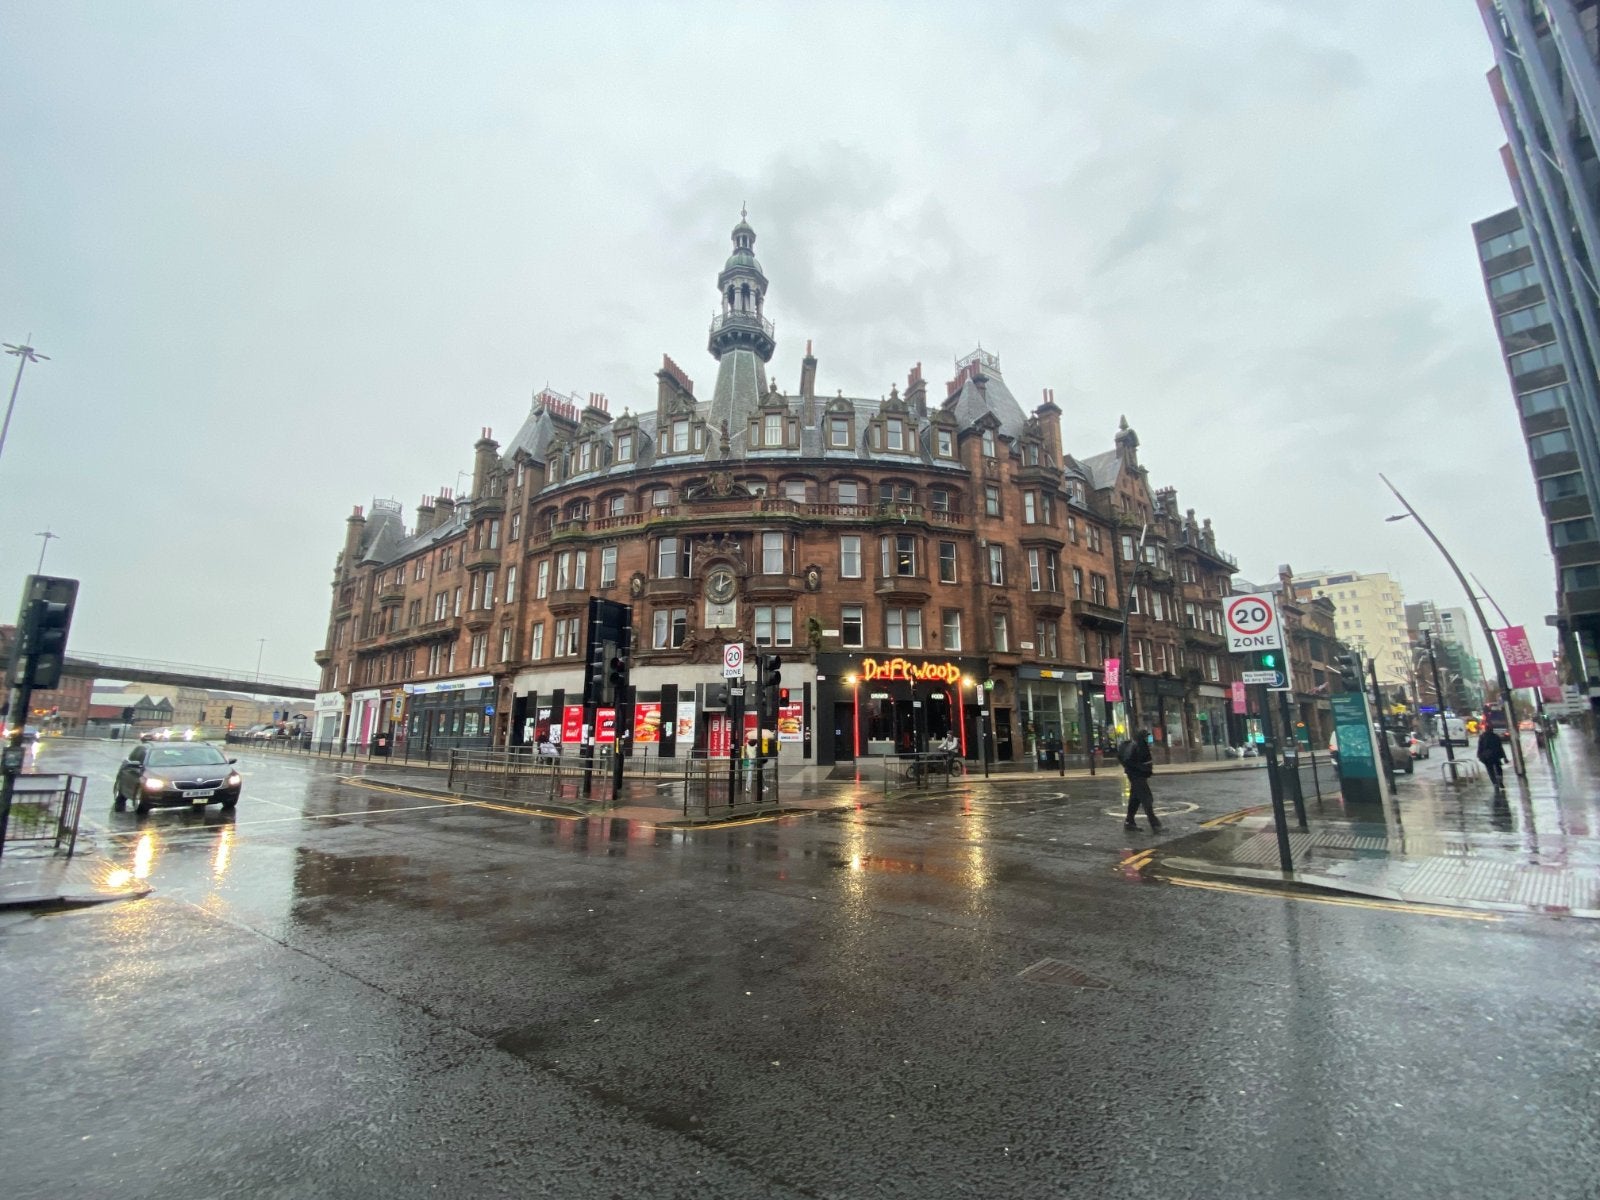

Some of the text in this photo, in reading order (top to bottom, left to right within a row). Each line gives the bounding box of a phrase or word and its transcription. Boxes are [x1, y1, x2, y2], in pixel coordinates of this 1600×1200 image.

[1235, 607, 1266, 625] 20
[1233, 635, 1275, 648] ZONE
[1497, 631, 1515, 666] GLASGOW
[728, 651, 740, 662] 20
[725, 668, 741, 676] ZONE
